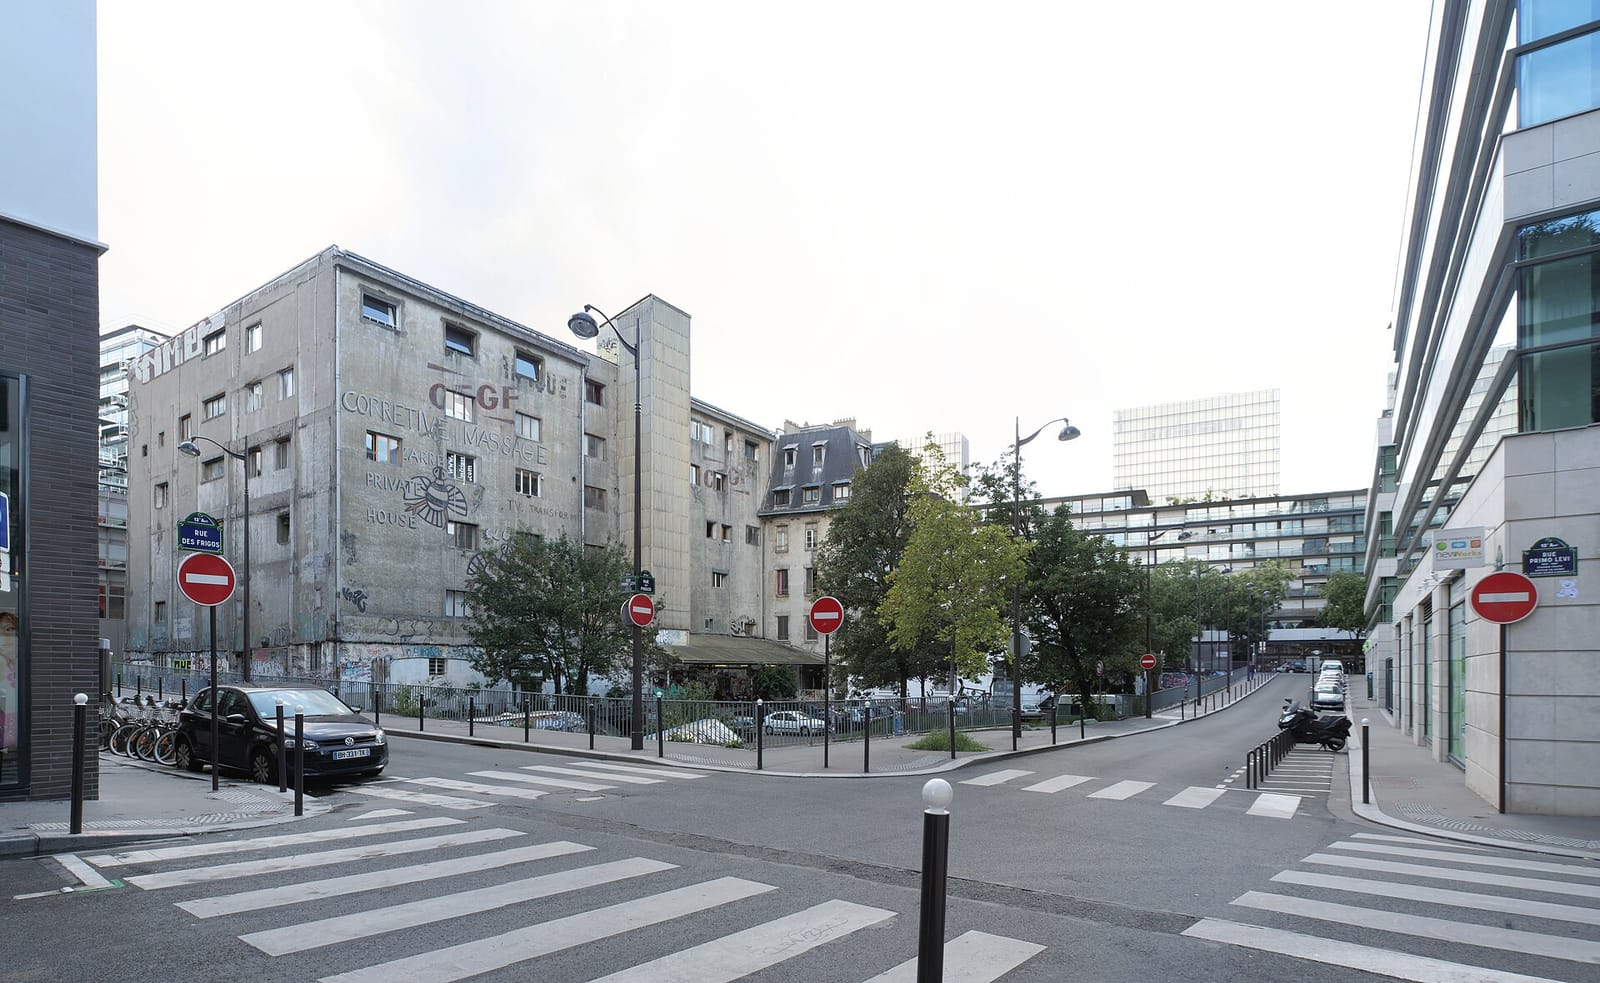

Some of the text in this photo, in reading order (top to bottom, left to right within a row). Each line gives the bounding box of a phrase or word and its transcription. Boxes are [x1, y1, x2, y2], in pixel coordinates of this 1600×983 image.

[463, 424, 548, 466] MASSAGE
[365, 471, 422, 495] PRIVATE
[366, 506, 417, 530] HOUSE
[181, 537, 220, 548] DES FRIGOS
[194, 529, 208, 537] RUE
